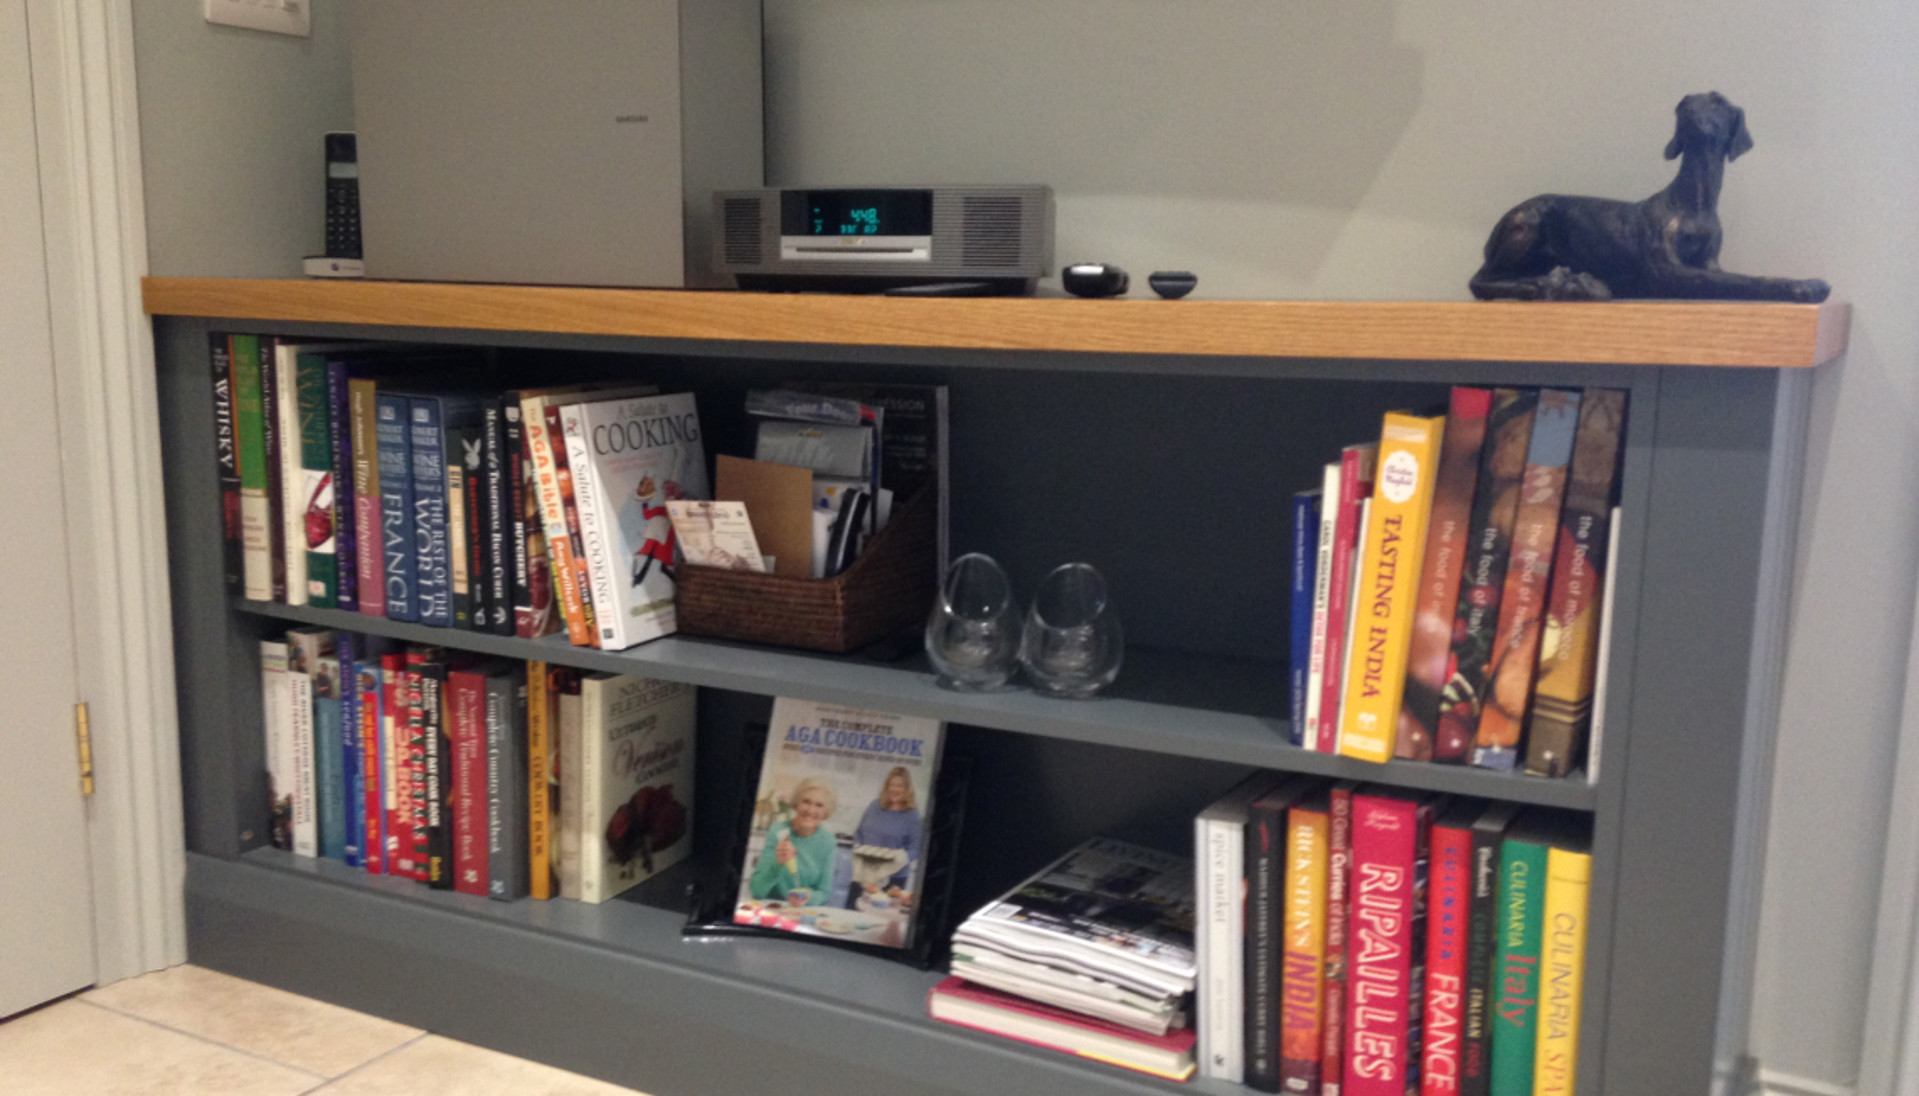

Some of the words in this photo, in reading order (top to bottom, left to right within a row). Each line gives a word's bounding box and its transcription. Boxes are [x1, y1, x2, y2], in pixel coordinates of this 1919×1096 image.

[214, 378, 234, 469] WHISKY
[486, 409, 497, 450] MANUAL
[593, 413, 698, 455] COOKING
[530, 425, 549, 469] AGA
[540, 472, 560, 521] Bible
[572, 446, 584, 460] A
[356, 459, 370, 494] Wine
[450, 470, 463, 489] GIN
[576, 464, 592, 511] Salute
[431, 496, 444, 527] THE
[490, 470, 502, 530] TRADITIONAL
[585, 512, 596, 526] to
[357, 497, 374, 579] Companion
[432, 530, 445, 567] REST
[1441, 520, 1455, 544] the
[1483, 527, 1498, 551] the
[1528, 524, 1542, 547] the
[1578, 516, 1593, 540] the
[384, 494, 408, 614] FRANCE
[414, 497, 436, 617] WORLD
[515, 522, 526, 587] BUTCHERY
[554, 540, 566, 566] Amy
[589, 528, 609, 604] COOKING
[1371, 514, 1403, 618] TASTING
[1435, 547, 1451, 577] food
[1476, 554, 1493, 586] food
[1521, 550, 1538, 583] food
[1571, 543, 1589, 576] food
[434, 569, 446, 590] OF
[1432, 581, 1444, 597] of
[1473, 589, 1487, 603] of
[1517, 586, 1531, 602] of
[1568, 579, 1583, 595] of
[435, 591, 448, 618] THE
[1467, 606, 1486, 637] italy
[1509, 605, 1530, 649] france
[1560, 598, 1580, 661] morocco
[1361, 626, 1388, 699] INDIA
[342, 700, 353, 747] seafood
[409, 672, 423, 742] NIGELLA
[457, 687, 469, 738] Complete
[486, 691, 499, 746] Complete
[820, 718, 840, 729] THE
[842, 721, 893, 735] COMPLETE
[427, 726, 438, 756] EVERY
[784, 724, 822, 745] AGA
[824, 729, 925, 757] COOKBOOK
[428, 776, 439, 800] COOK
[460, 741, 471, 796] Traditional
[488, 748, 500, 794] Country
[412, 747, 427, 841] CHRISTMAS
[429, 801, 440, 827] BOOK
[460, 797, 471, 832] Recipe
[490, 798, 502, 854] Cookbook
[534, 821, 545, 856] BOOK
[461, 834, 472, 860] Book
[1212, 831, 1228, 869] spice
[1297, 825, 1314, 869] RICK
[1330, 852, 1345, 901] Curries
[1214, 873, 1229, 923] market
[1293, 875, 1313, 948] STEIN'S
[1330, 902, 1343, 914] of
[1440, 846, 1457, 960] CULINARIA
[1507, 860, 1529, 947] CULINARIA
[1328, 915, 1342, 946] India
[1284, 950, 1318, 1030] INDIA
[1354, 861, 1404, 1081] RIPAILLES
[1496, 953, 1538, 1027] Italy
[1547, 912, 1577, 1040] CULINARIA
[1425, 972, 1460, 1090] FRANCE
[1468, 988, 1484, 1038] ITALIAN
[1467, 1042, 1481, 1078] FOOD
